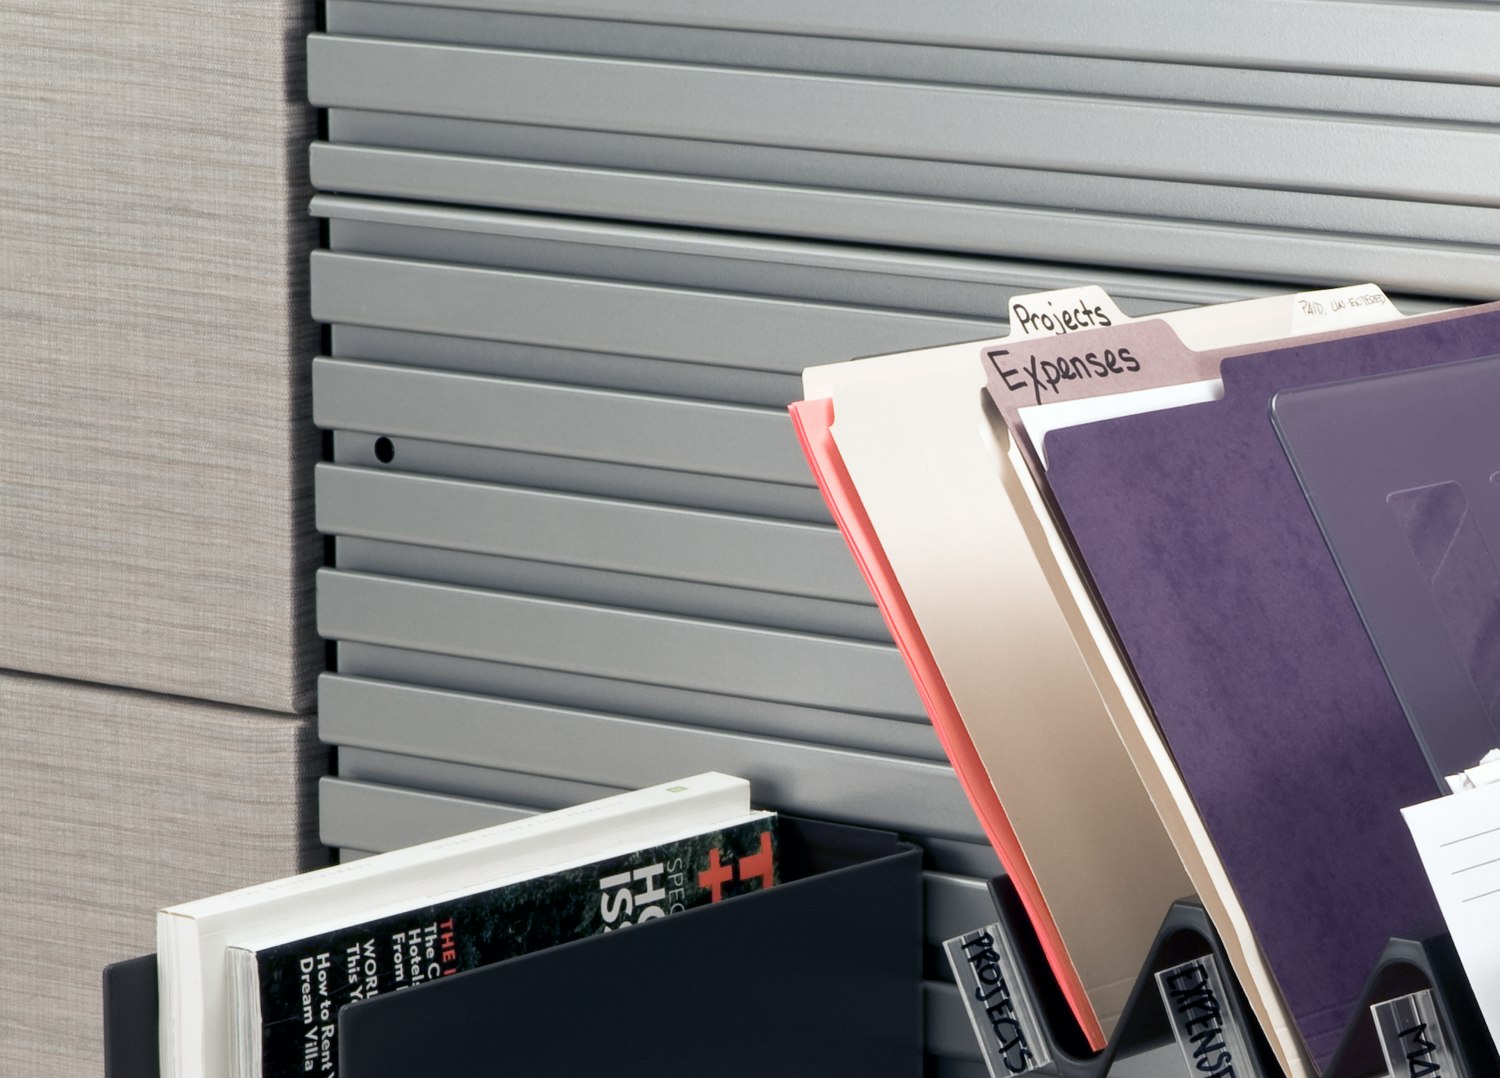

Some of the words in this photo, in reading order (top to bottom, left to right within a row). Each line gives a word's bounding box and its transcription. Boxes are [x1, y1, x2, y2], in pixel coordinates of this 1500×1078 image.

[1013, 302, 1112, 335] Projects
[987, 346, 1140, 405] Expenses
[392, 932, 406, 982] From
[423, 923, 437, 958] The
[440, 918, 456, 962] THE
[316, 953, 331, 996] How
[346, 942, 362, 984] This
[299, 956, 314, 1024] Dream
[320, 999, 332, 1021] to
[961, 931, 1034, 1075] PROJECTS
[303, 1026, 319, 1073] Villa
[319, 1024, 334, 1070] Rent
